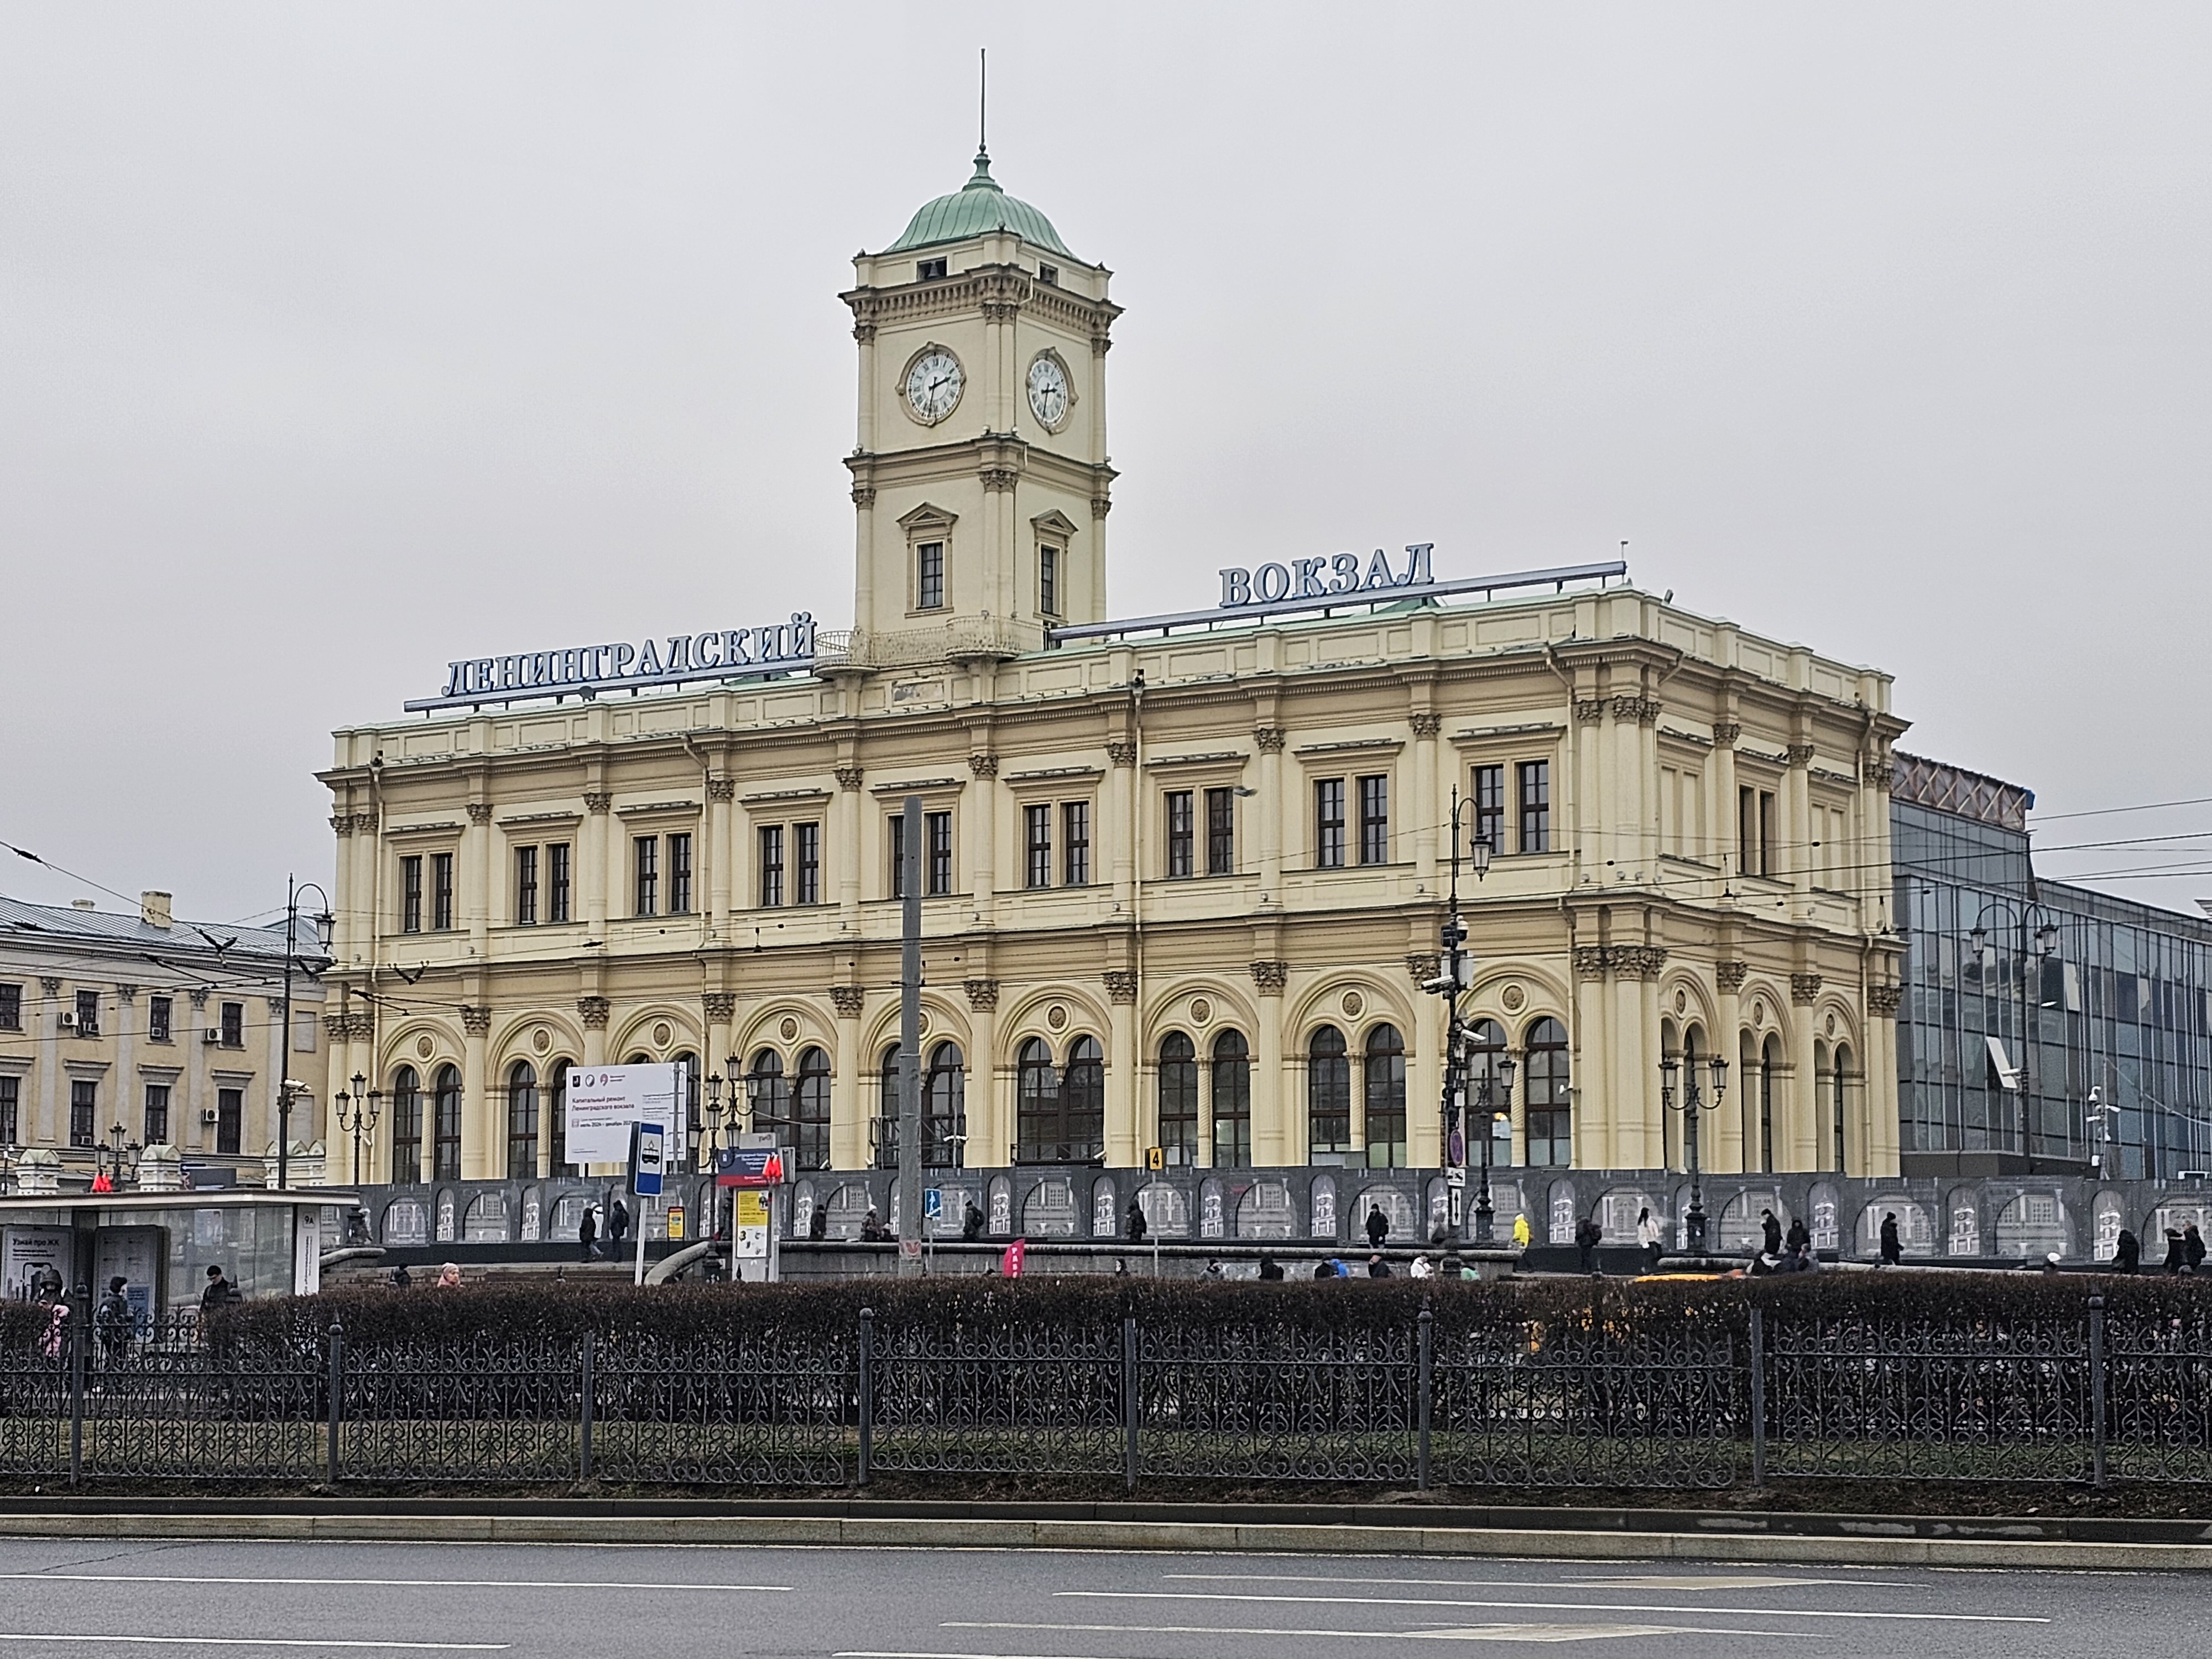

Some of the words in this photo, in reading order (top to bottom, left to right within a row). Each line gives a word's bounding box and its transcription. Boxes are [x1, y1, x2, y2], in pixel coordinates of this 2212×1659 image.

[441, 612, 817, 697] ЛЕНИНГРАДСКИЙ
[1219, 543, 1434, 608] ВОКЗАЛ
[1152, 1151, 1159, 1166] 4
